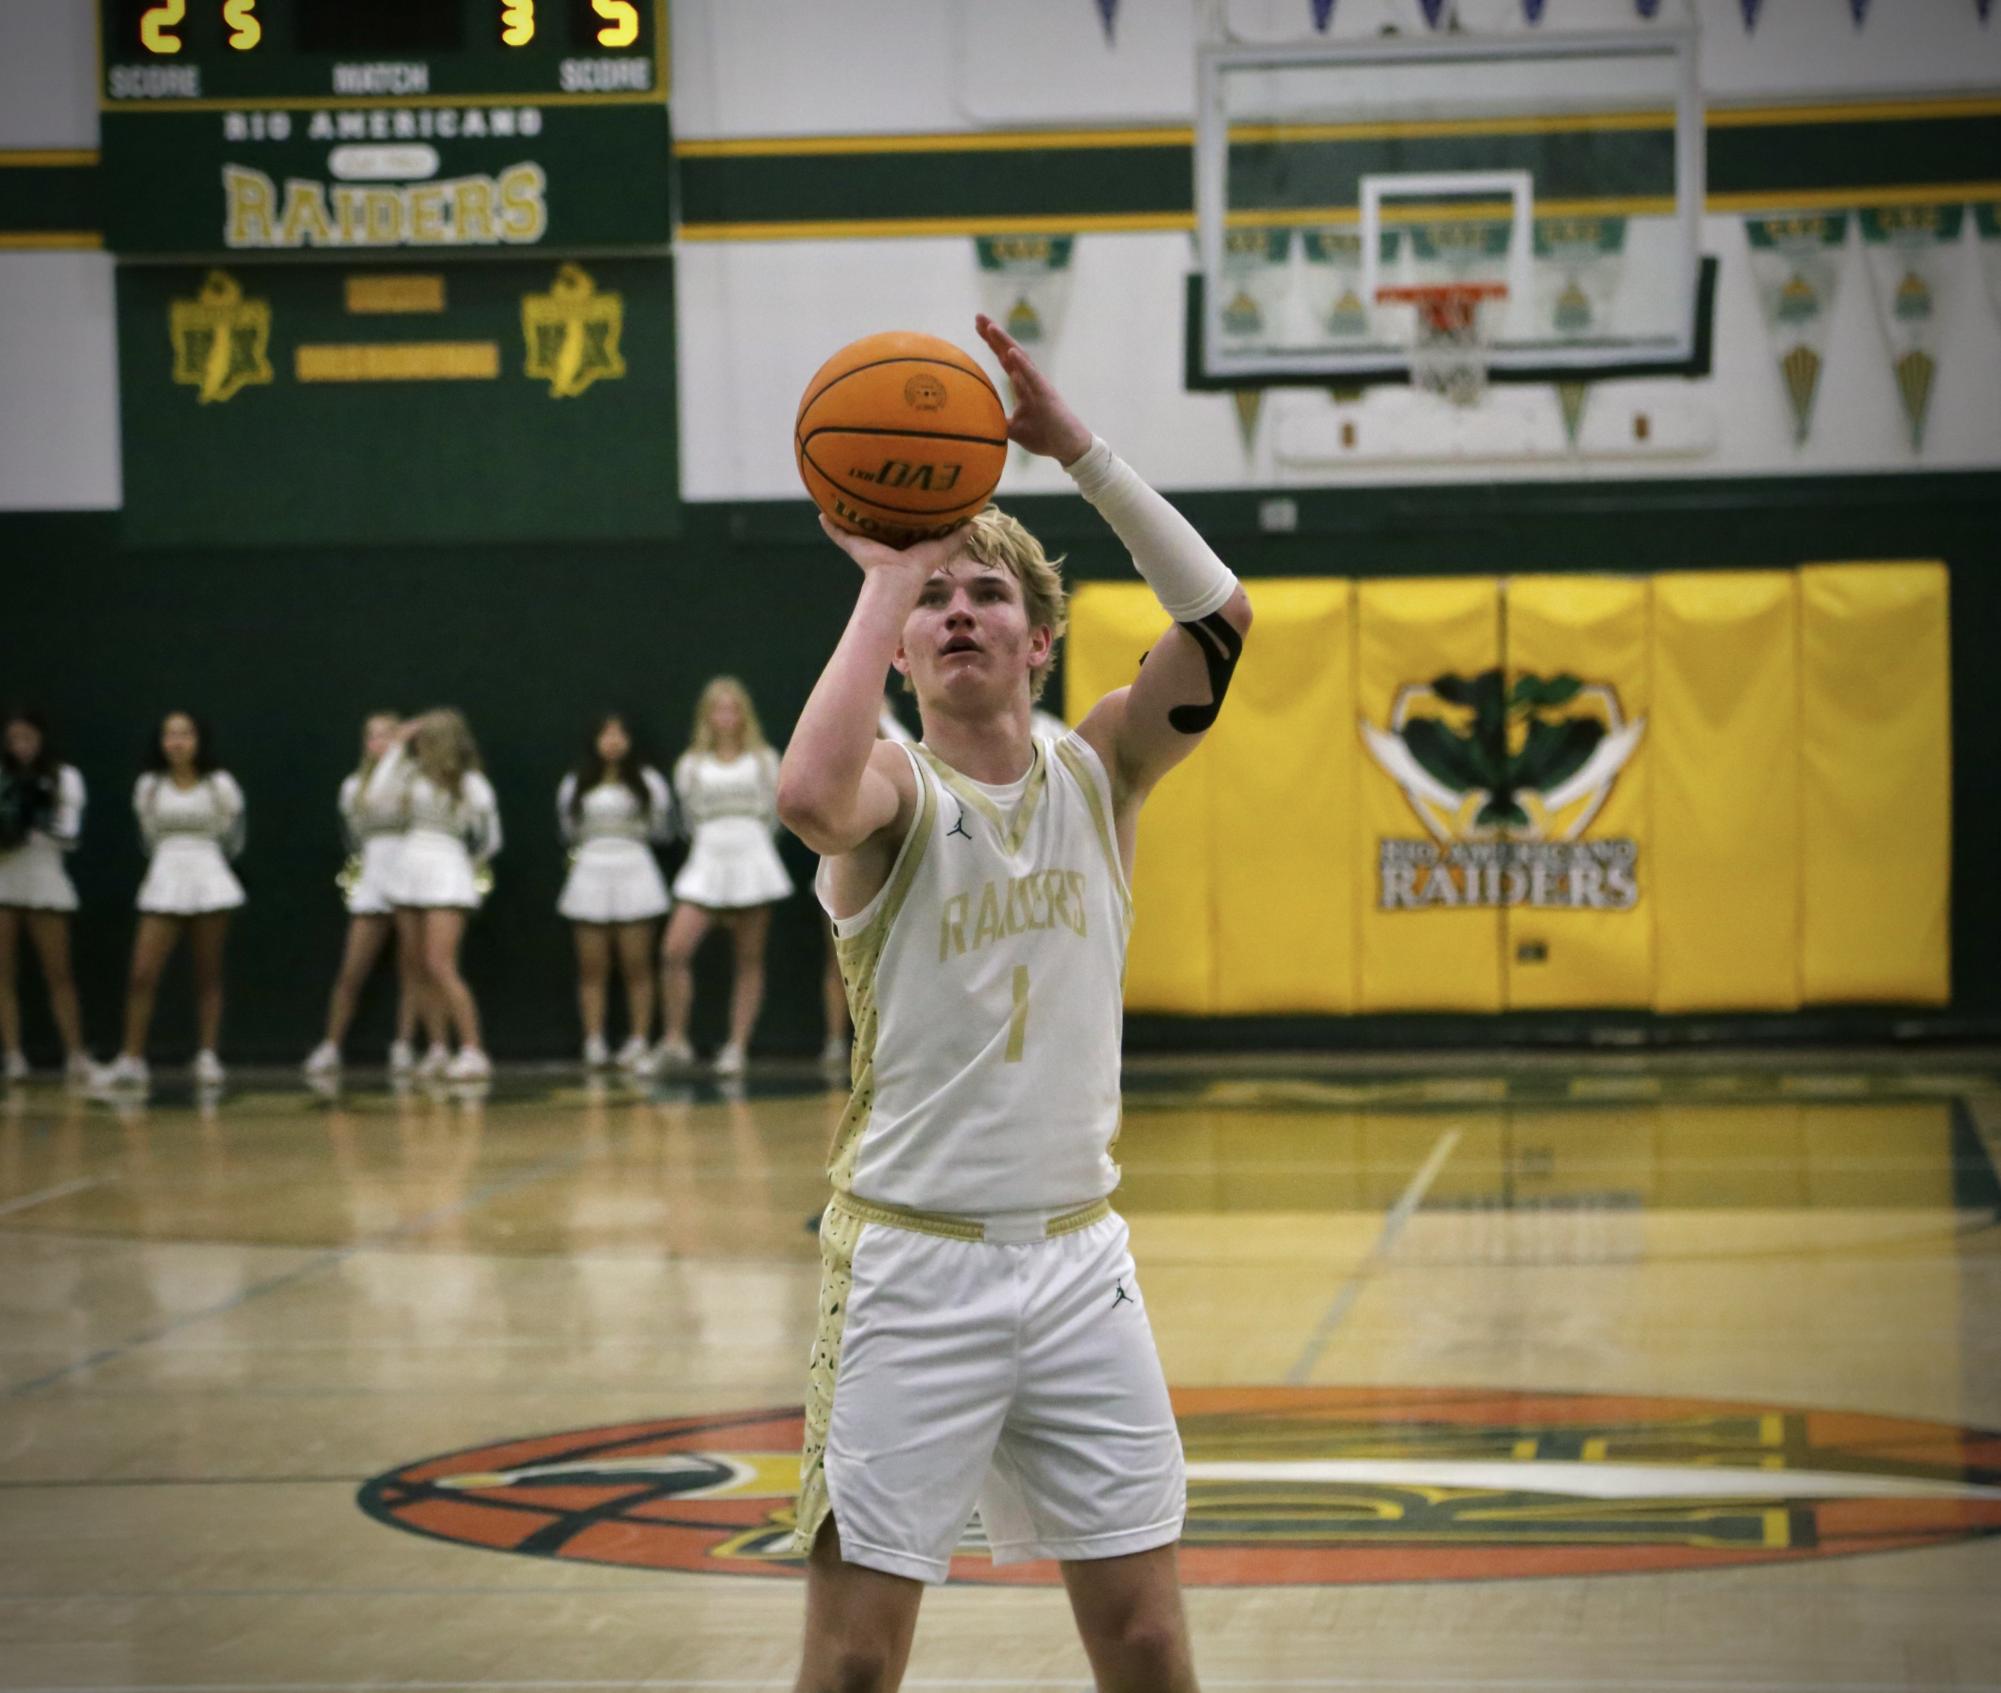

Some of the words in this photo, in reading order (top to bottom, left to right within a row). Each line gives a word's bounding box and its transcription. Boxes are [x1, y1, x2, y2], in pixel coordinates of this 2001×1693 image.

[141, 0, 186, 53] 2
[109, 64, 200, 98] SCORE
[332, 62, 429, 95] MATCH
[559, 57, 650, 91] SCORE
[223, 110, 292, 141] RIO
[308, 107, 542, 139] AMERICANO
[222, 160, 548, 249] RAIDERS
[1380, 862, 1639, 910] RAIDERS
[1004, 964, 1030, 1063] 1
